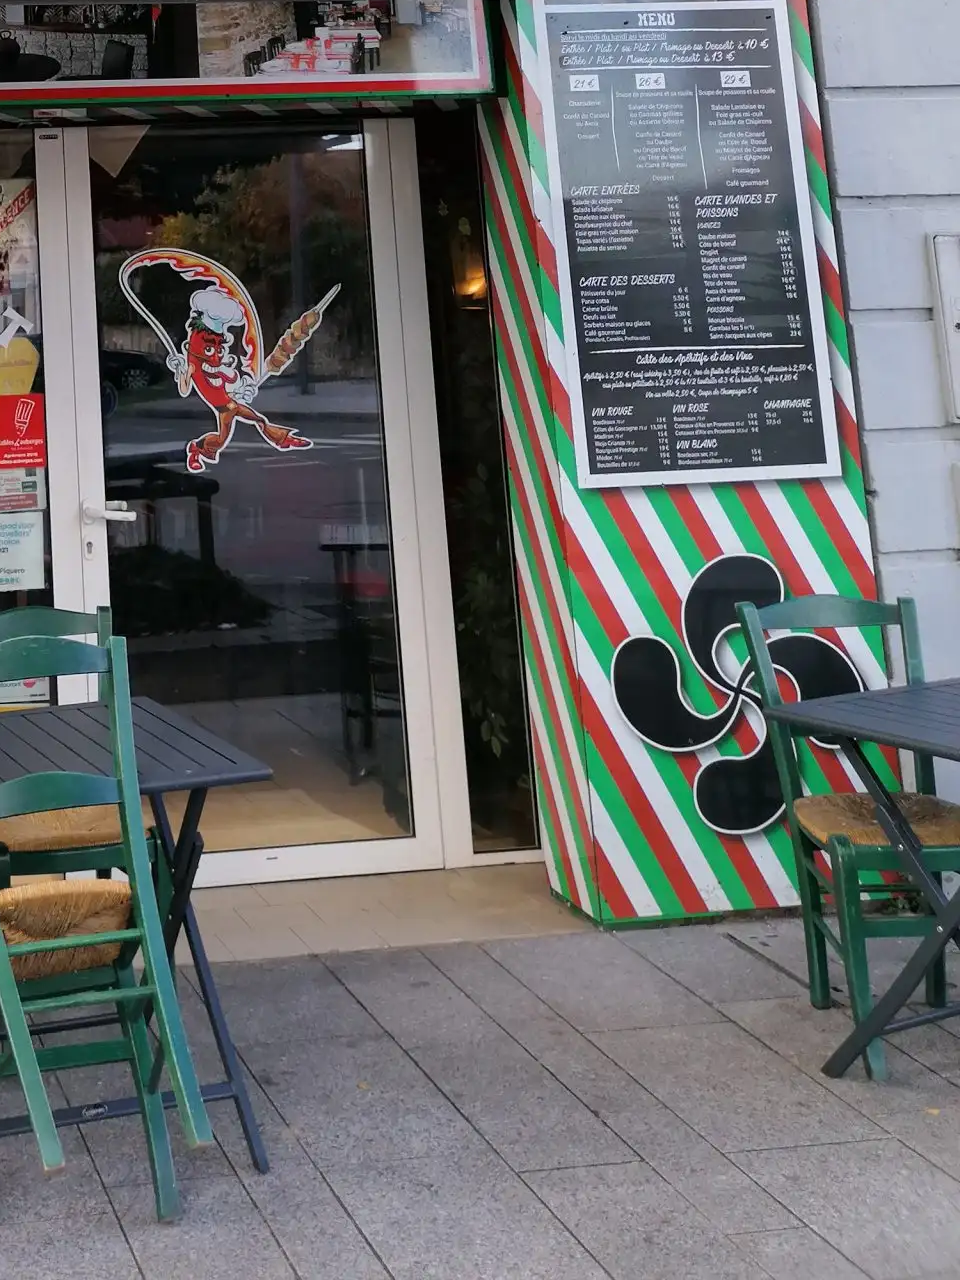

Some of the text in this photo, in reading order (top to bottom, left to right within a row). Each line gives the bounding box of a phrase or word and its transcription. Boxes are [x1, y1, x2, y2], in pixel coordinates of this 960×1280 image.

[638, 13, 675, 26] MENU
[571, 183, 640, 196] CARTE ENTRÉES
[695, 193, 778, 205] CARTE VIANDES ET
[696, 207, 739, 218] POISSONS
[580, 274, 675, 287] CARTE DES DESSERTS
[672, 403, 709, 413] VIN ROSE
[764, 398, 812, 409] CHAMPAGNE
[592, 406, 634, 417] VIN ROUGE
[676, 440, 690, 450] VIN
